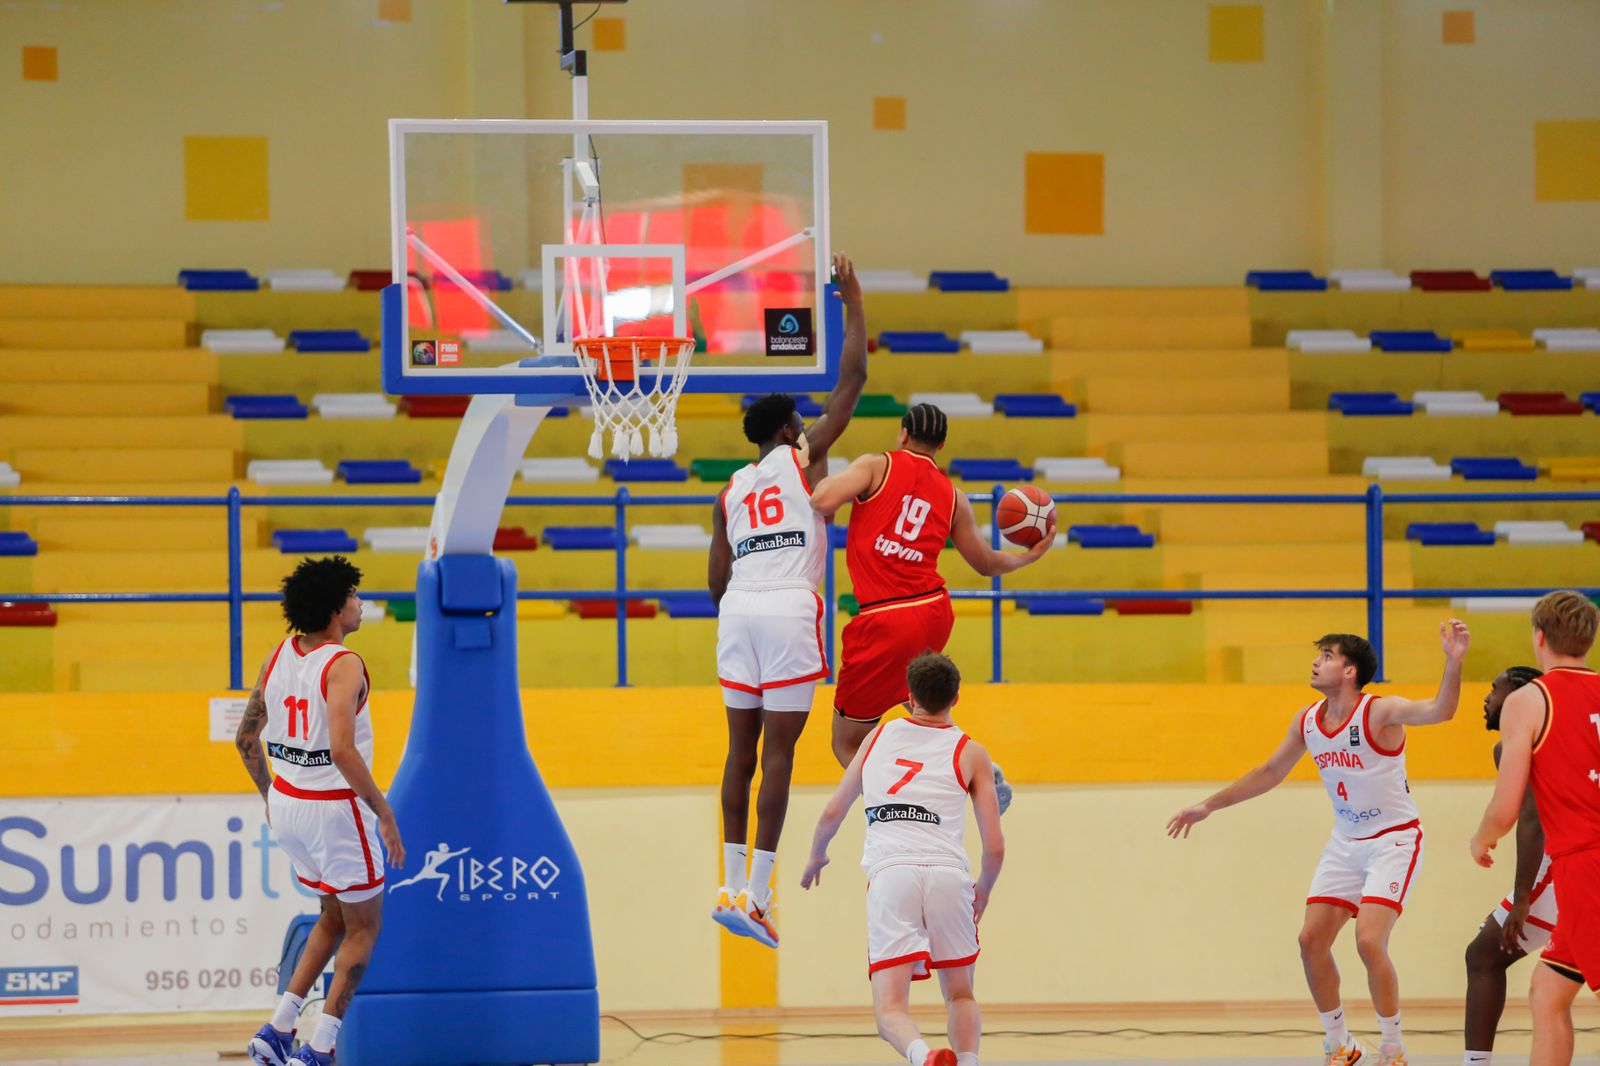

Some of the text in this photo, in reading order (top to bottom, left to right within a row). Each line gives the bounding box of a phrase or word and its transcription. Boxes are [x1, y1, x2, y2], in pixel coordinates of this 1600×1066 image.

[441, 343, 458, 353] FIBA
[770, 335, 808, 344] baloncesto
[742, 485, 784, 529] 16
[894, 494, 932, 541] 19
[747, 533, 804, 552] CaixaBank
[283, 695, 309, 741] 11
[282, 747, 330, 766] CaixaBank
[1313, 749, 1365, 769] ESPAÑA
[886, 758, 924, 795] 7
[1337, 781, 1348, 801] 4
[877, 806, 938, 823] CaixaBank
[459, 855, 560, 893] IBERO
[460, 892, 560, 901] SPORT
[5, 971, 74, 992] SKF
[146, 970, 190, 991] 956
[198, 968, 241, 989] 020
